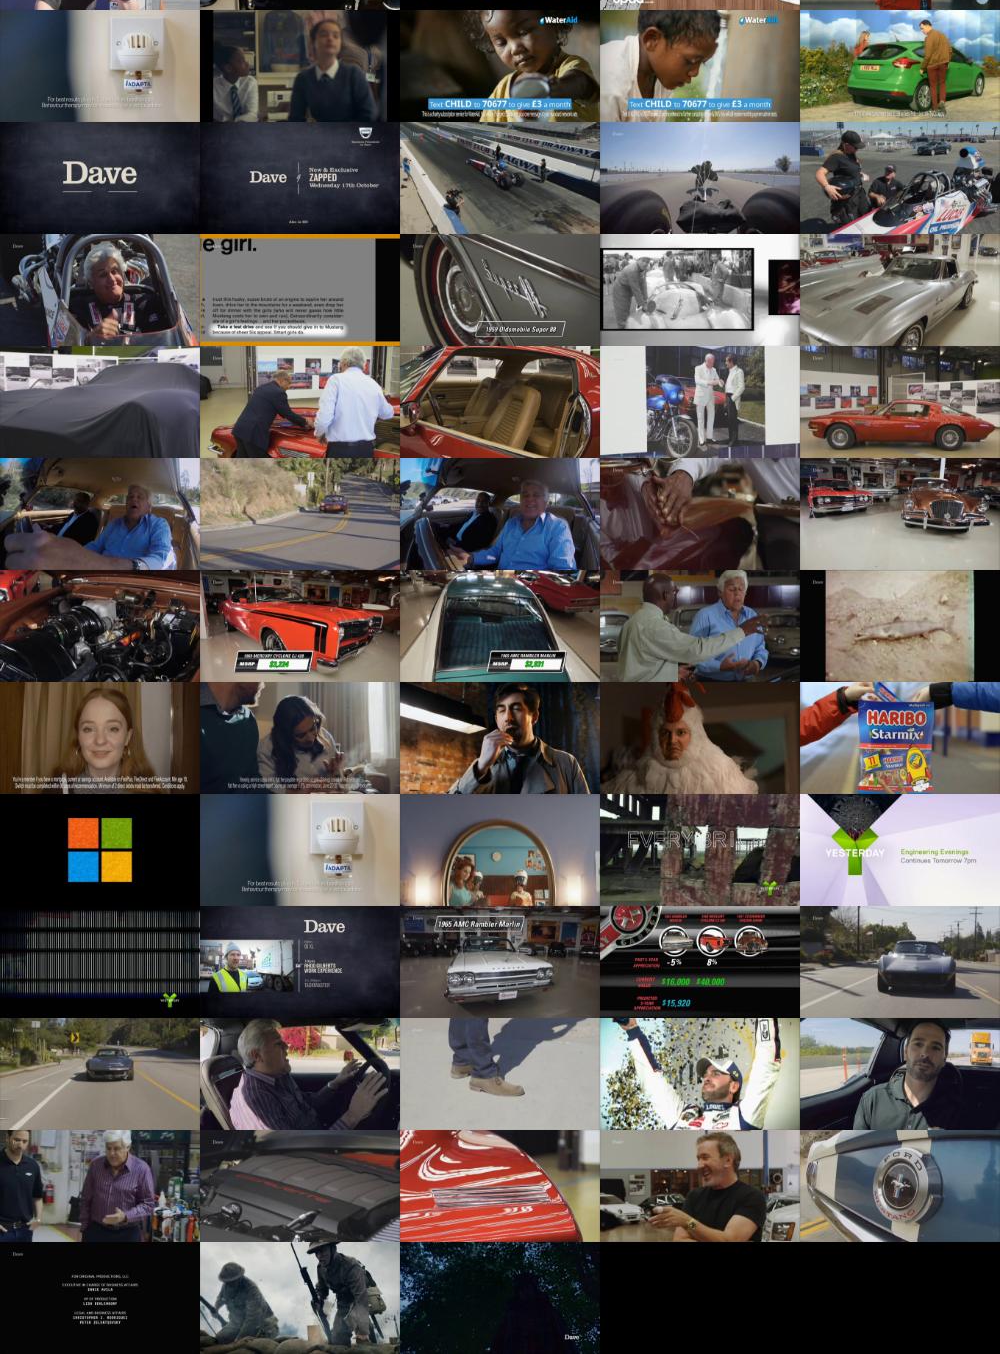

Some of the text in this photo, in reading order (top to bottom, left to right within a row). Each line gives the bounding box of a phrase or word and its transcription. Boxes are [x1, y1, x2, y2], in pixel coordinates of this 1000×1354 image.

[62, 161, 137, 185] Dave
[250, 170, 288, 184] Dave
[309, 173, 337, 182] ZAPPED
[220, 238, 257, 255] girl.
[867, 709, 928, 727] HARIBO
[871, 728, 920, 741] Starmix
[825, 848, 886, 857] YESTERDAY
[900, 848, 969, 856] Engineering Evenings
[964, 857, 977, 865] 7pm
[304, 919, 346, 933] Dave
[667, 958, 718, 967] -5% 8%
[662, 999, 691, 1007] $15,920
[884, 1151, 923, 1172] FORD
